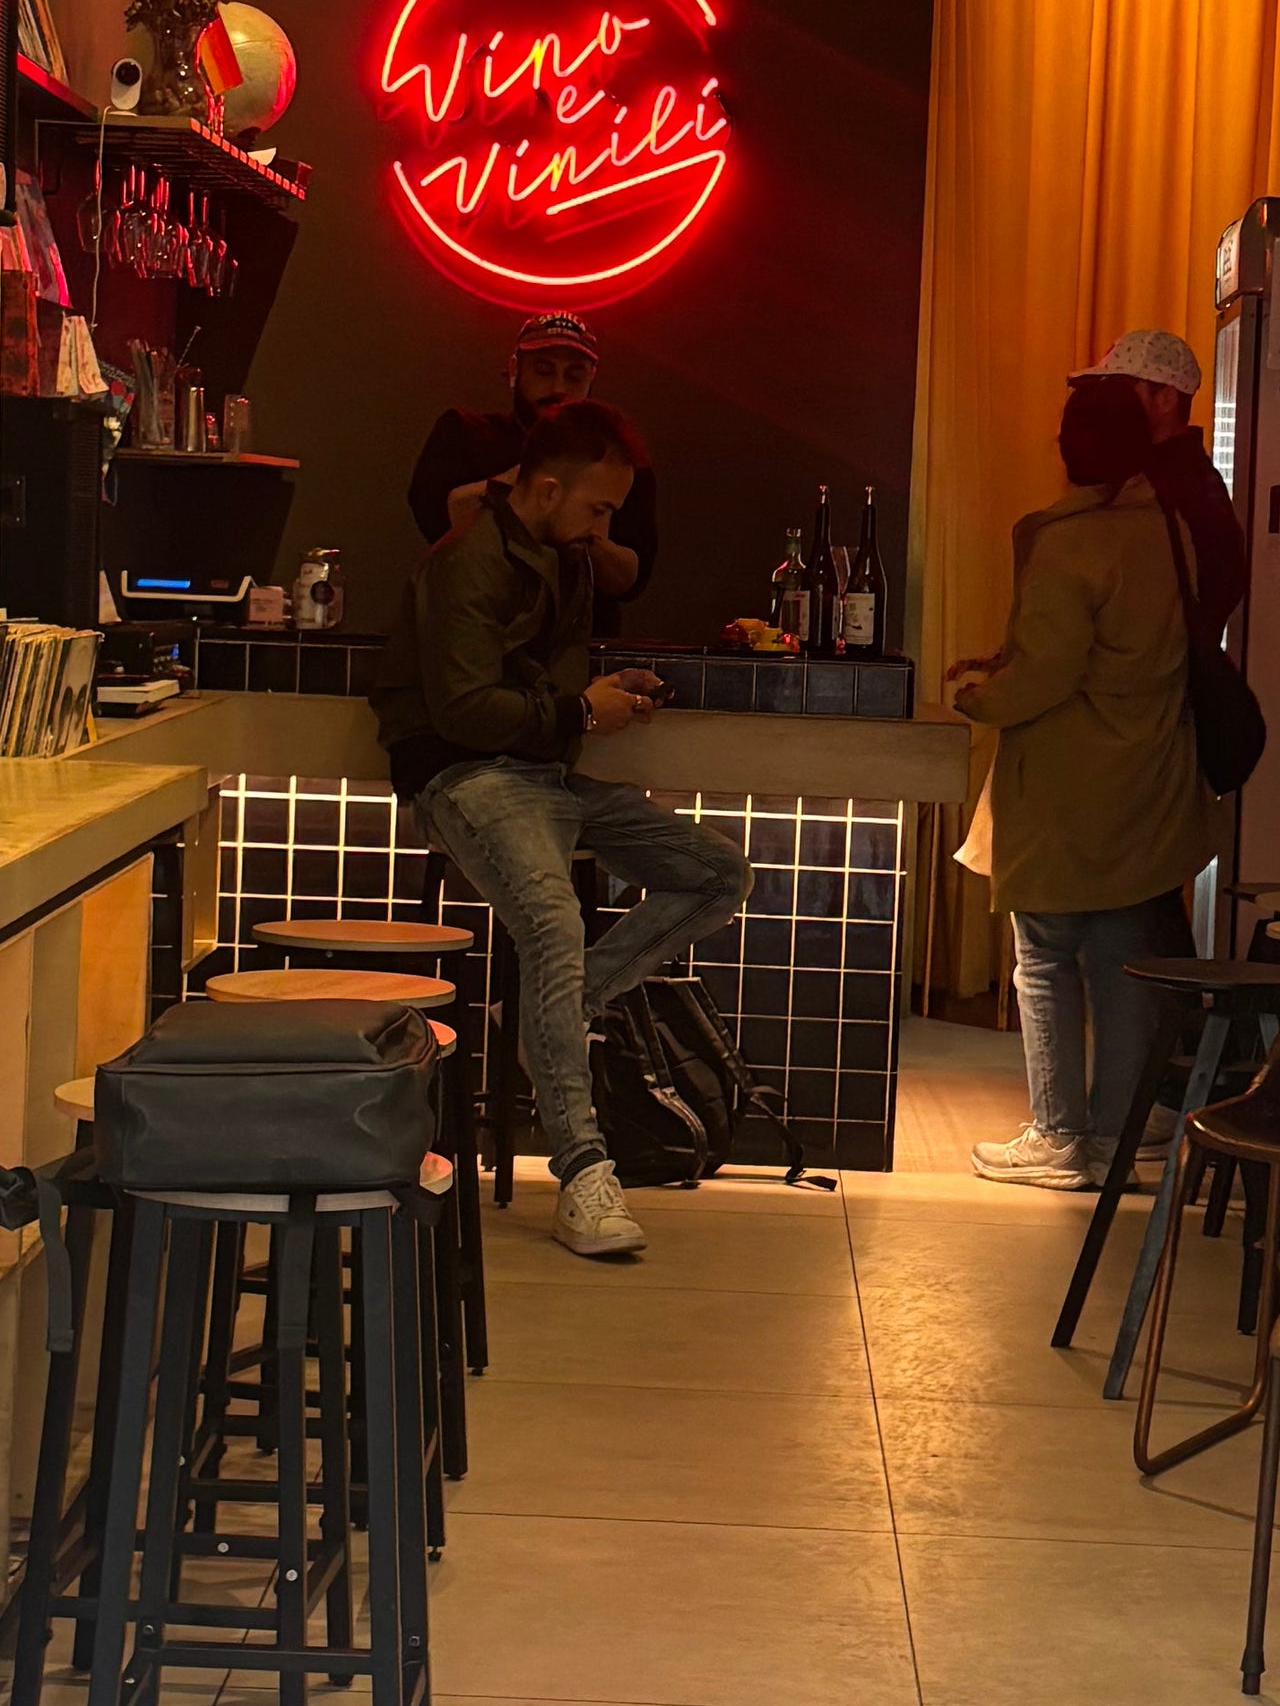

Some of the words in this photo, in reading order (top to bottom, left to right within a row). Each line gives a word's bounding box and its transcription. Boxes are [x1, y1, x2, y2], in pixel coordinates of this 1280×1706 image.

[384, 11, 650, 123] Vino
[556, 85, 606, 123] e
[420, 77, 729, 213] Vinili
